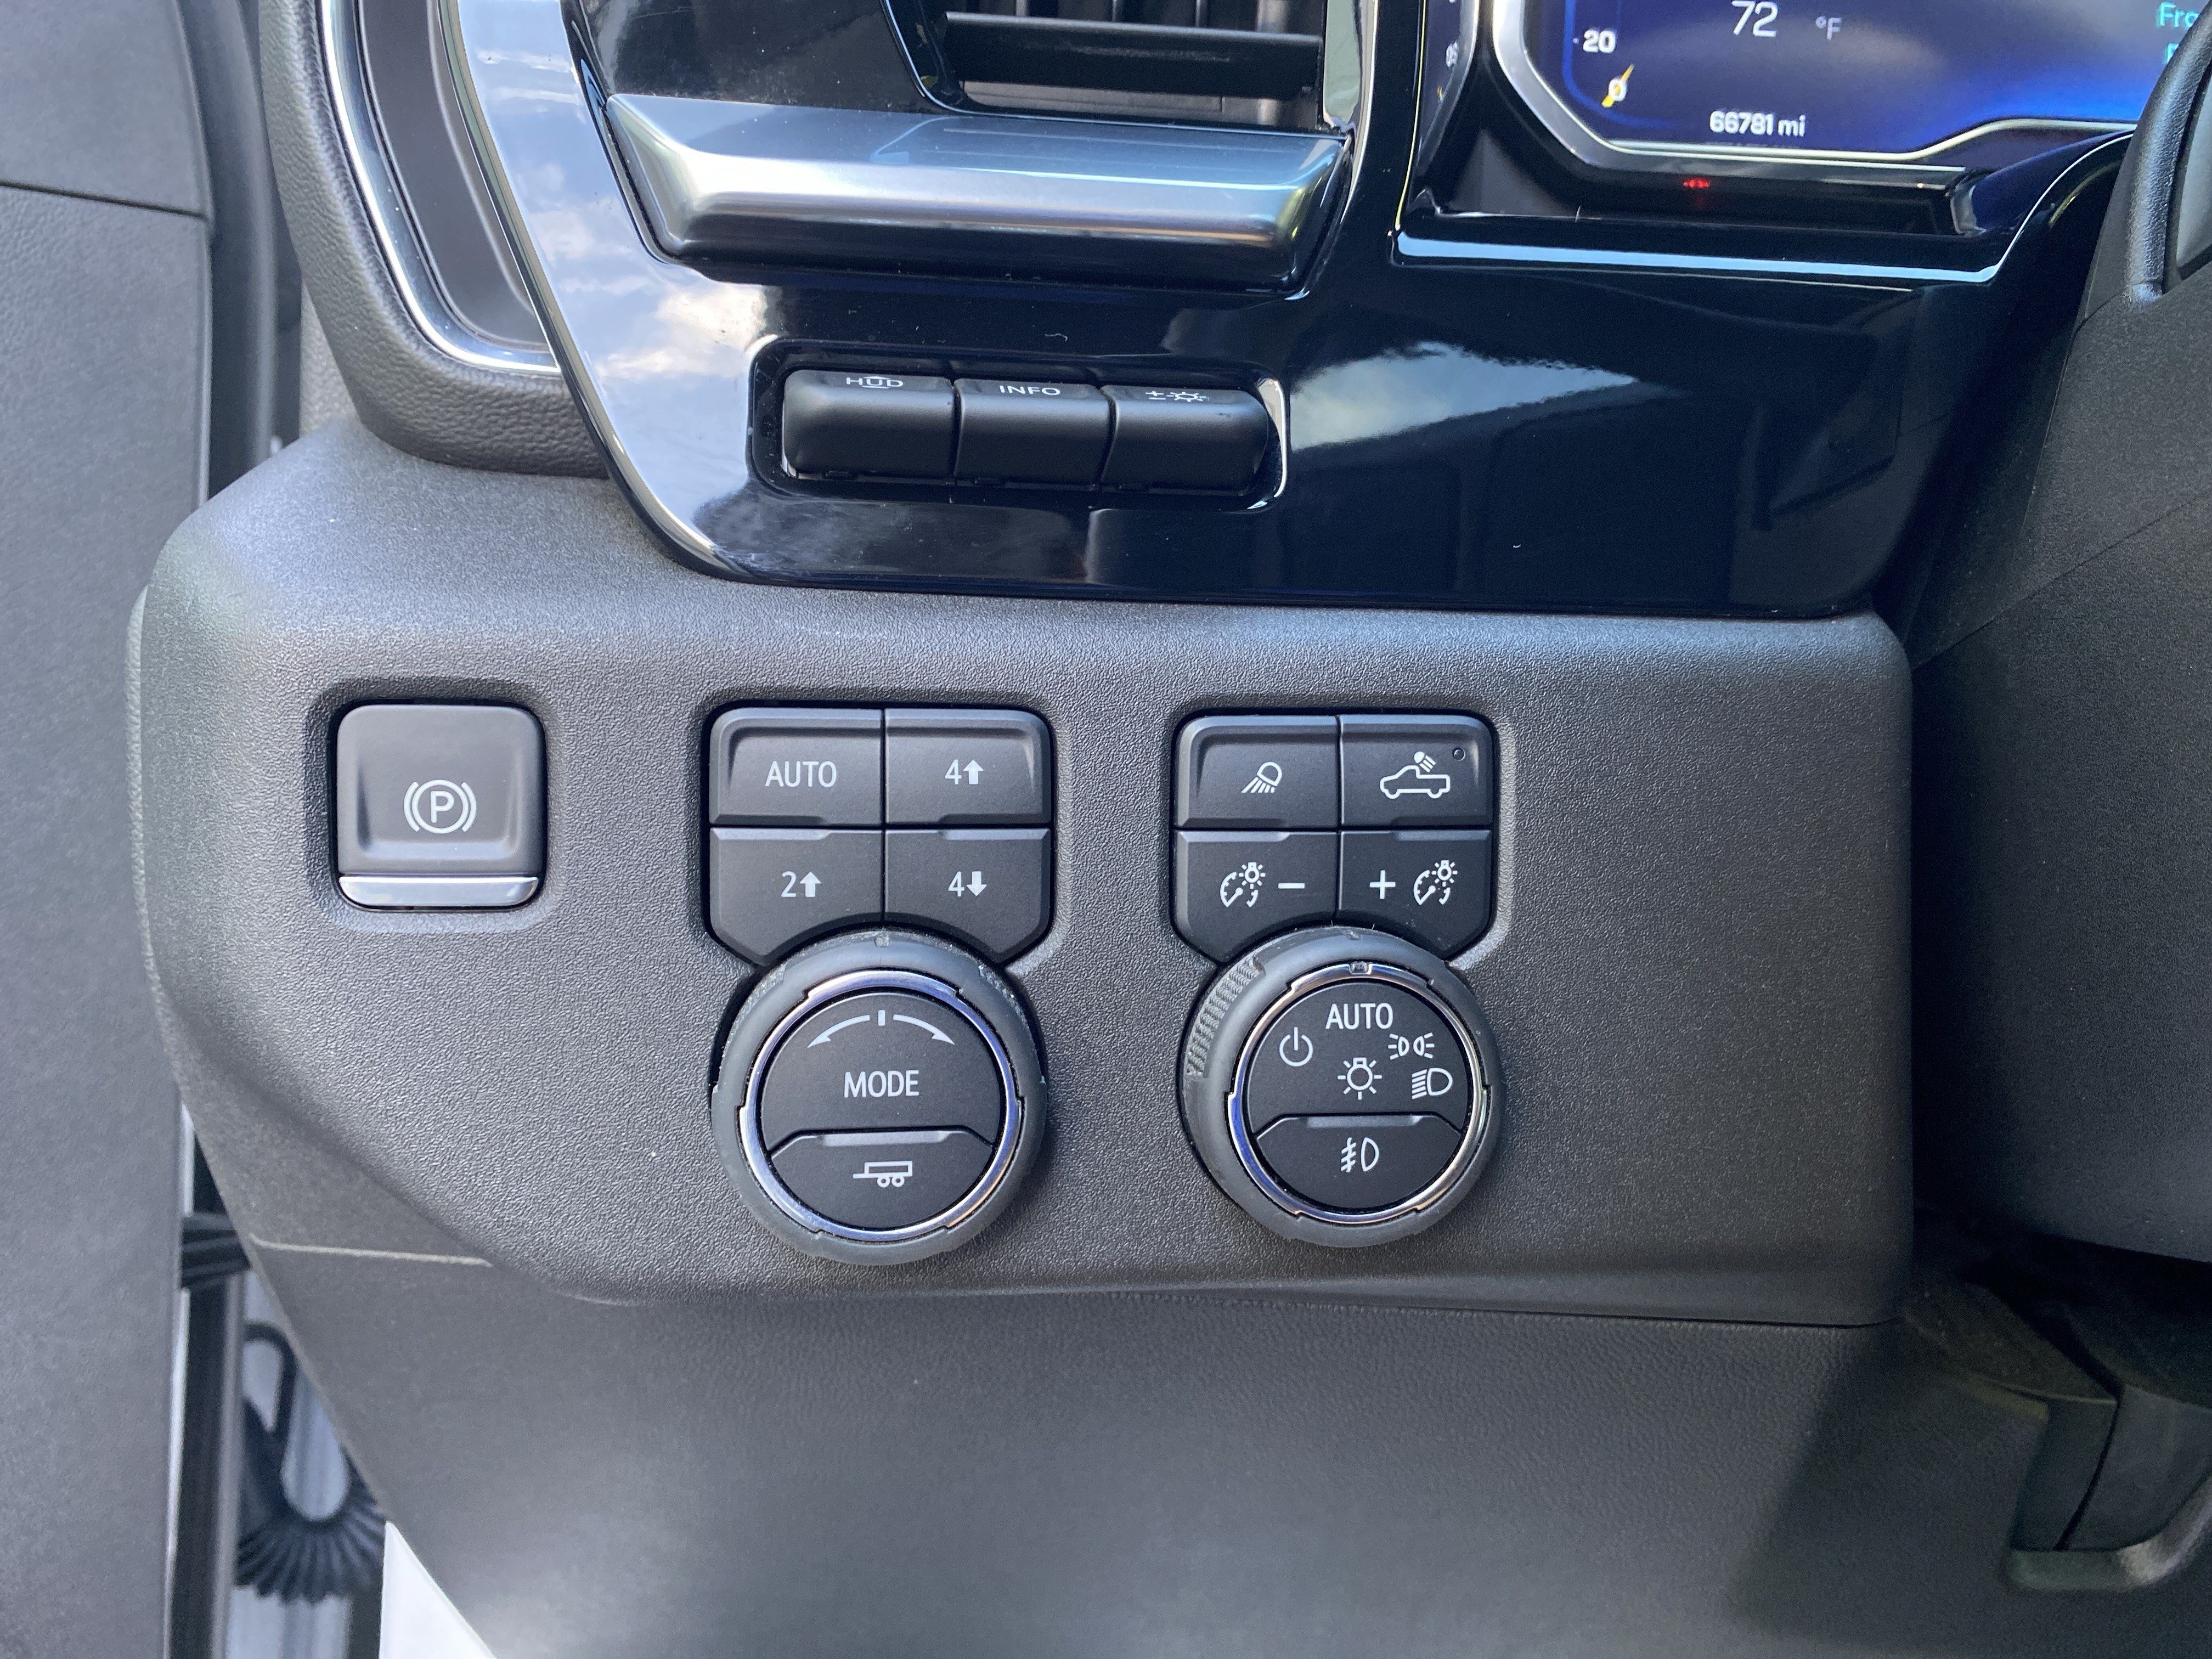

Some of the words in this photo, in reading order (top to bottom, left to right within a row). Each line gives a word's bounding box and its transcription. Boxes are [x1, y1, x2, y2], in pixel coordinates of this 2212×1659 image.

[1731, 0, 1778, 37] 72
[1583, 30, 1617, 54] 20
[1608, 77, 1627, 102] 0
[1709, 110, 1774, 136] 66781
[1778, 114, 1806, 137] mi
[846, 376, 904, 389] HUD
[999, 385, 1061, 396] INFO
[765, 760, 837, 788] AUTO
[945, 759, 962, 785] 4
[430, 790, 453, 823] P
[781, 871, 797, 898] 2
[948, 871, 966, 897] 4
[1325, 1002, 1394, 1030] AUTO
[844, 1070, 919, 1098] MODE
